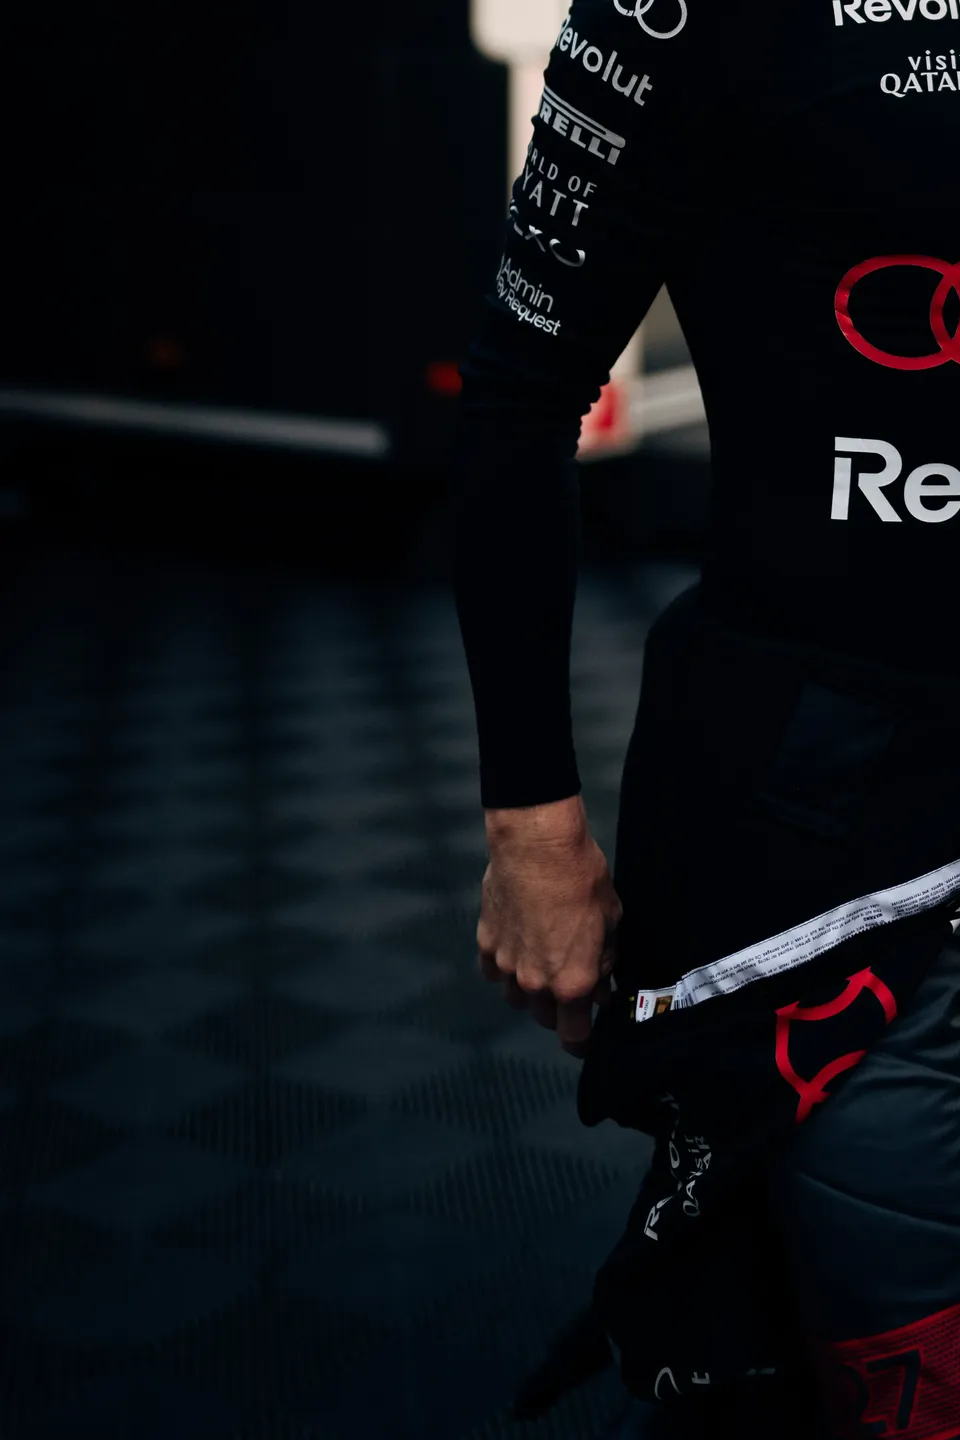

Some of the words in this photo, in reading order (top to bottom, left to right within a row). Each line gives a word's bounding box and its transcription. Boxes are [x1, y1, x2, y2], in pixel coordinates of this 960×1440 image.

[522, 163, 589, 227] YATT
[567, 175, 598, 198] OF
[501, 257, 554, 313] Admin
[504, 288, 561, 336] Request
